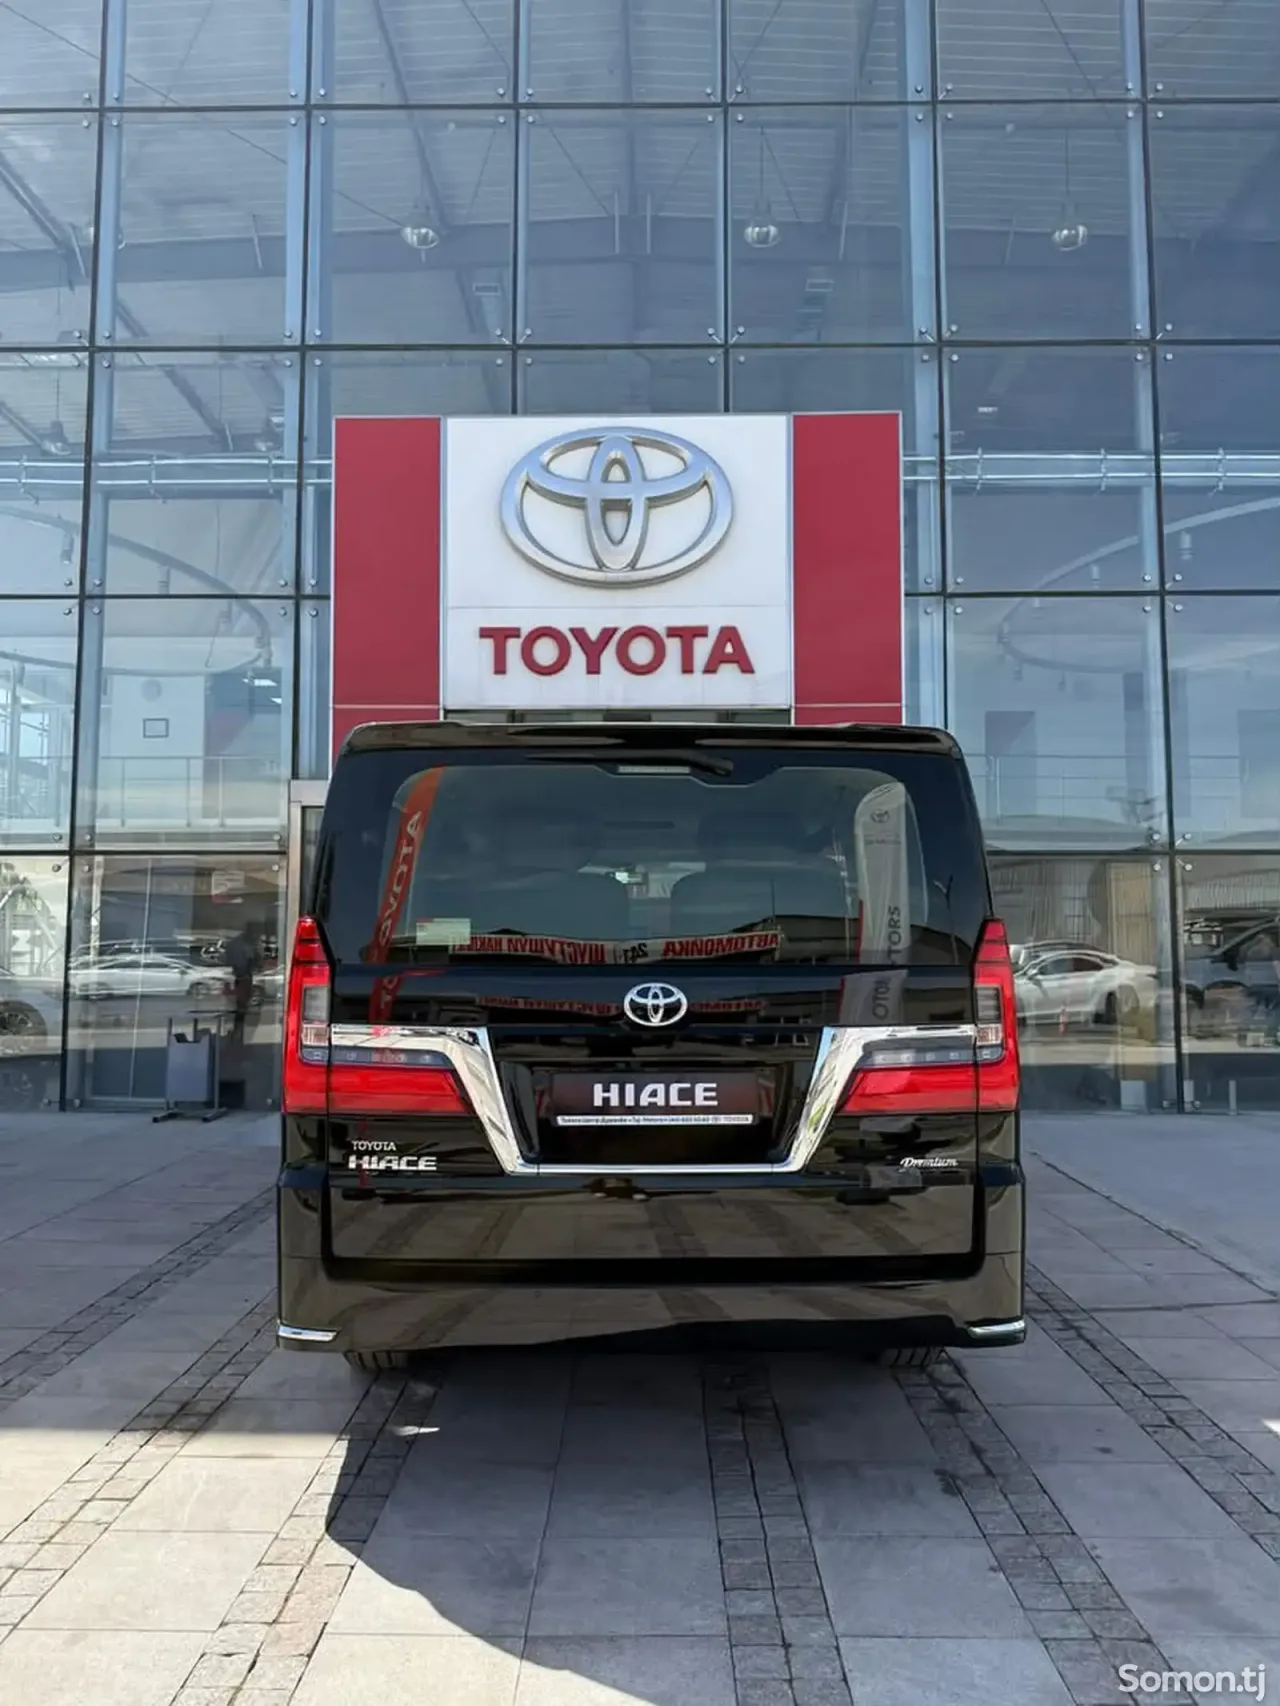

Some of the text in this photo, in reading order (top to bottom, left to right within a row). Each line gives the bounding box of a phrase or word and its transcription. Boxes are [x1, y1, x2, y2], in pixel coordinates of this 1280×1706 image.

[479, 625, 756, 676] TOYOTA
[593, 1083, 718, 1107] HIACE
[352, 1140, 397, 1151] TOYOTA
[348, 1155, 437, 1170] HIACE
[900, 1157, 959, 1168] Premium
